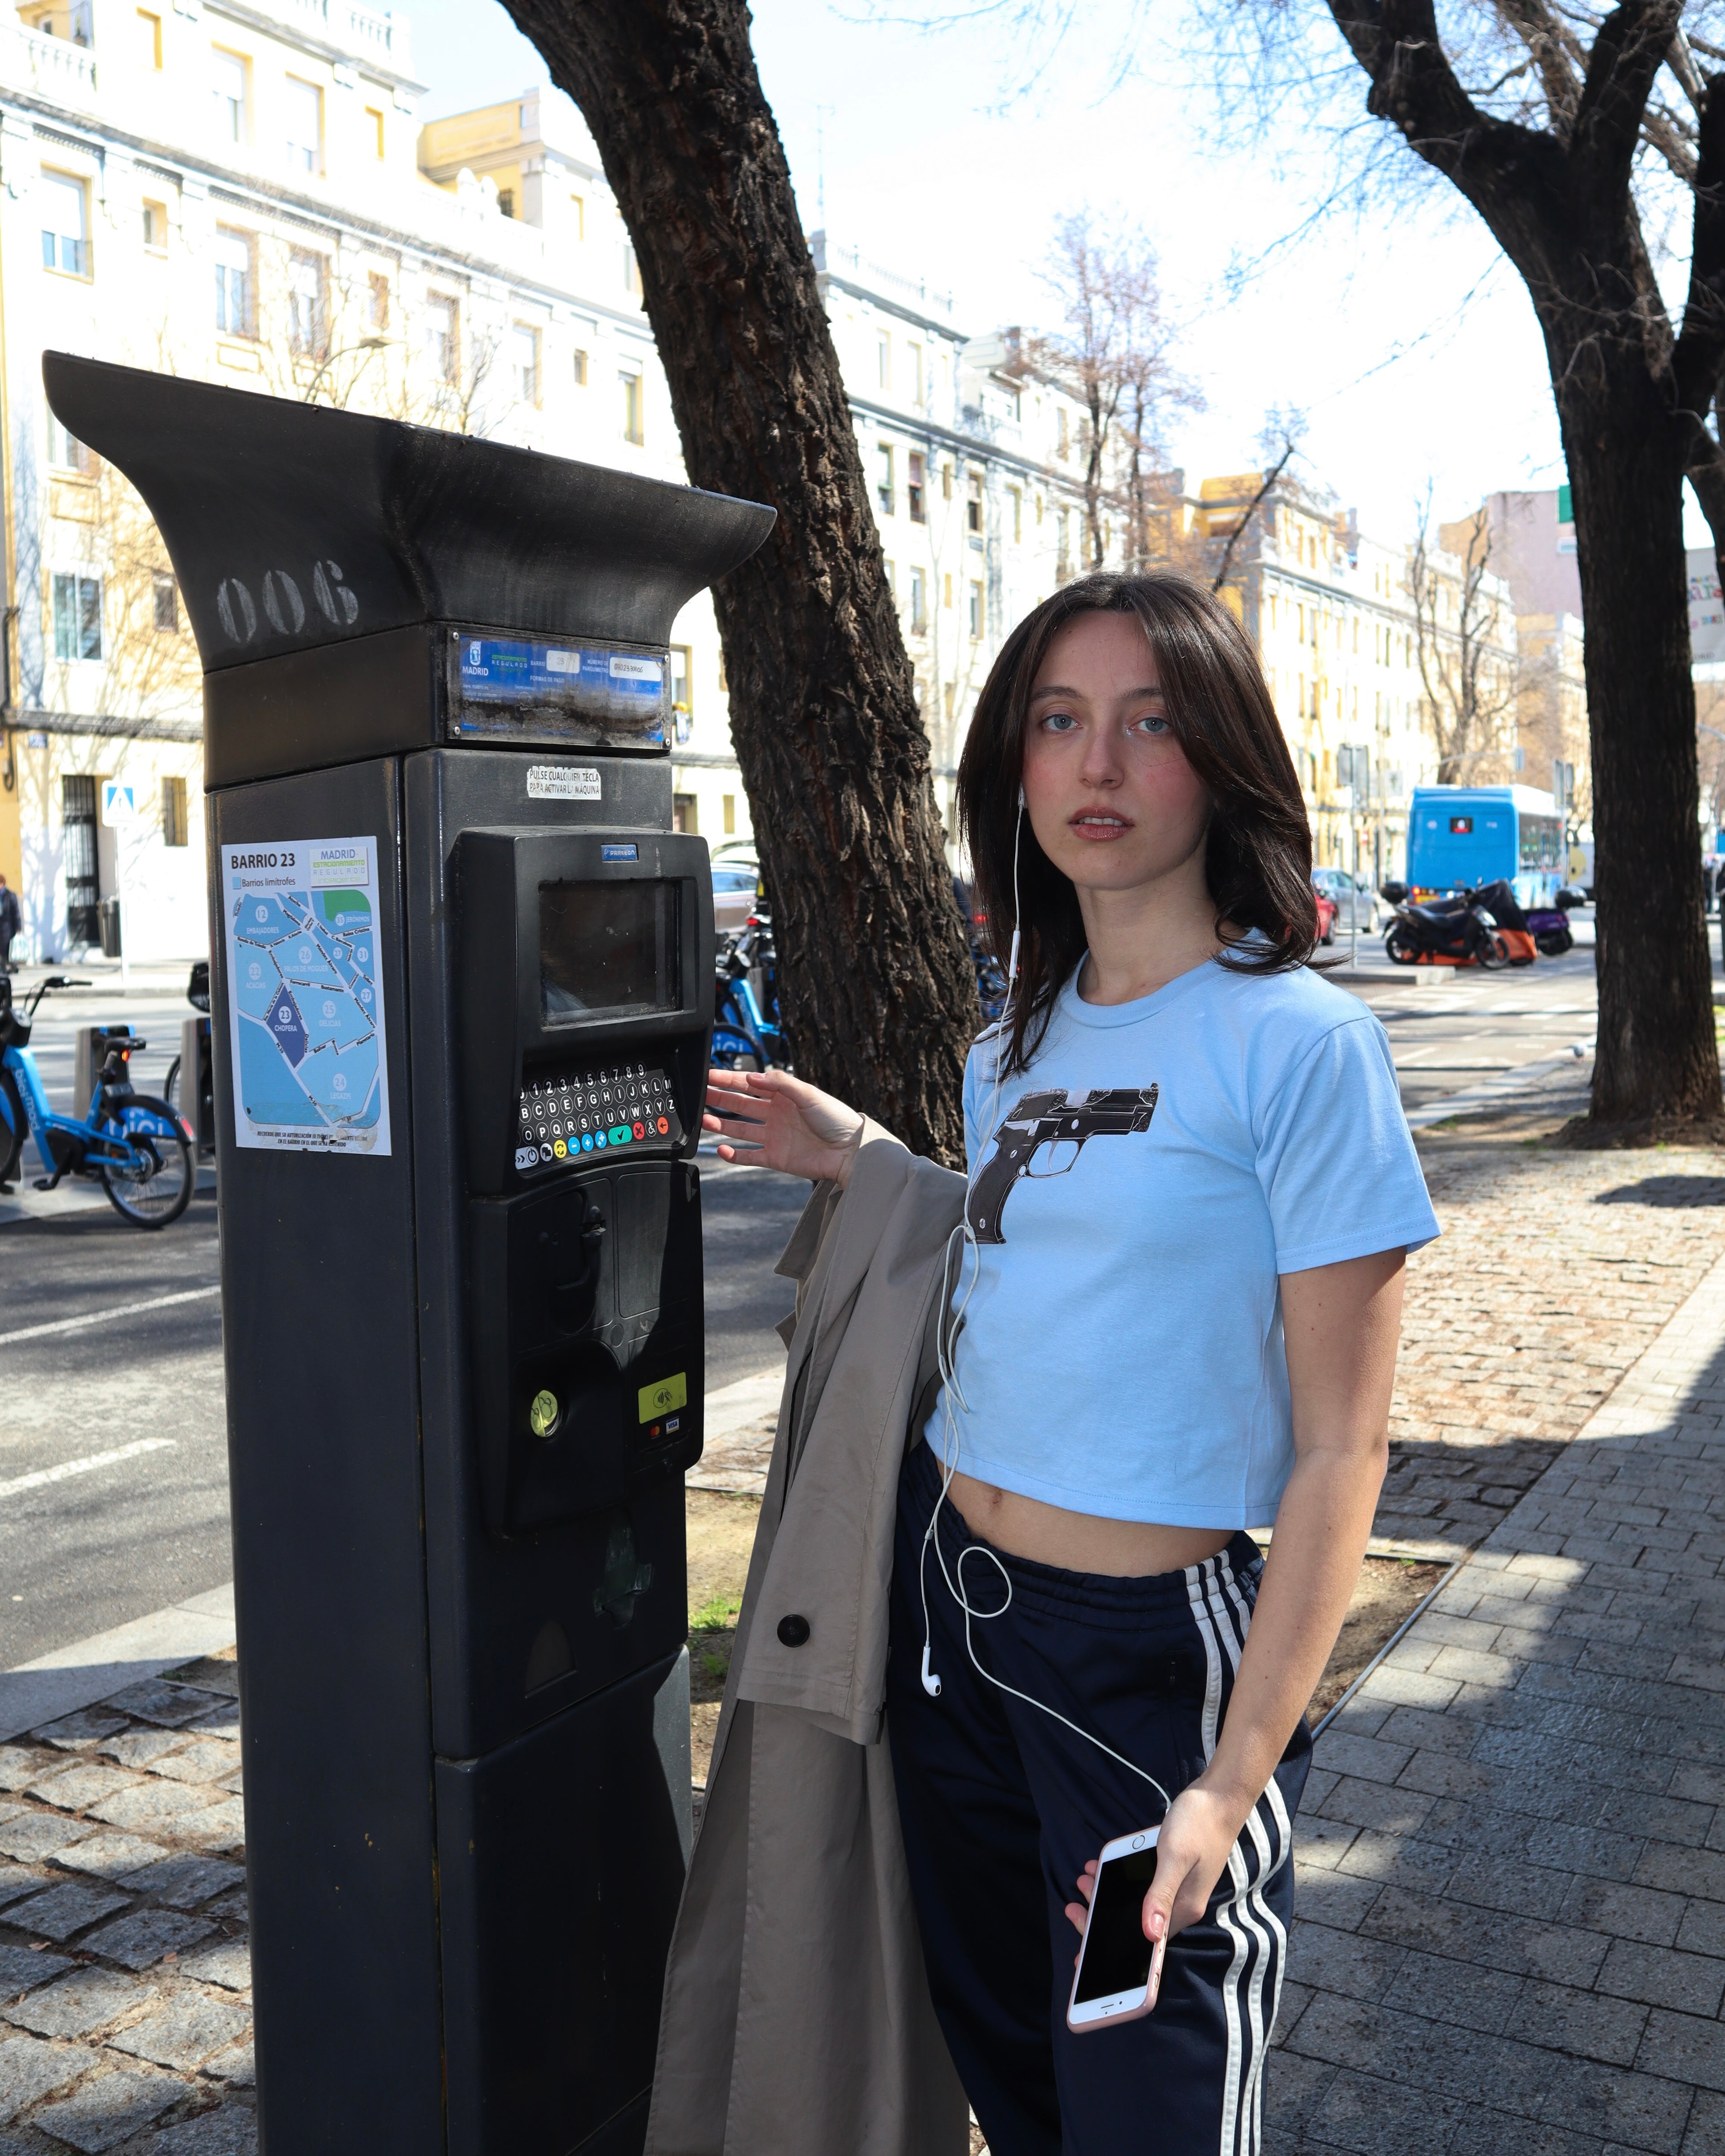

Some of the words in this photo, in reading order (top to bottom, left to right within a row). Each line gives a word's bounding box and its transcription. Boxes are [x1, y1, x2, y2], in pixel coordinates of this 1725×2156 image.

[217, 559, 359, 643] 006
[462, 666, 489, 676] MADRID
[530, 770, 547, 780] PULSE
[583, 773, 599, 782] TECLA
[545, 783, 566, 794] ACTIVAR
[575, 783, 599, 795] MÁQUINA
[321, 849, 355, 860] MADRID
[231, 853, 277, 869] BARRIO
[280, 853, 295, 867] 23
[313, 867, 365, 875] REGULADO
[242, 879, 263, 887] Barrios
[265, 876, 296, 886] limítrofes
[288, 896, 301, 907] Atocha
[257, 910, 266, 919] 12
[283, 909, 301, 926] Magdalena
[346, 915, 370, 923] JERÓNIMOS
[247, 927, 279, 935] EMBAJADORES
[336, 937, 352, 948] Barcelona
[301, 950, 310, 959] 26
[269, 950, 283, 978] Embajadores
[251, 967, 260, 976] 22
[288, 990, 302, 1020] Embajadores
[324, 1005, 334, 1014] 25
[280, 1010, 290, 1019] 23
[356, 1033, 375, 1046] Planetario
[276, 1043, 284, 1054] M-30
[335, 1078, 345, 1087] 24
[533, 1083, 538, 1095] 1
[546, 1081, 553, 1094] 2
[560, 1078, 567, 1091] 3
[574, 1076, 580, 1088] 4
[587, 1074, 593, 1086] 5
[600, 1071, 606, 1083] 6
[613, 1069, 619, 1080] 7
[626, 1066, 632, 1078] 8
[638, 1064, 644, 1076] 9
[309, 1096, 317, 1106] M-30
[522, 1108, 528, 1118] B
[535, 1105, 542, 1115] C
[549, 1103, 556, 1113] D
[564, 1100, 571, 1110] E
[577, 1096, 583, 1107] F
[590, 1094, 597, 1104] G
[603, 1091, 610, 1102] H
[618, 1089, 621, 1099] I
[630, 1087, 635, 1096] J
[641, 1083, 648, 1094] K
[654, 1082, 659, 1091] L
[664, 1079, 672, 1089] M
[540, 1127, 545, 1138] P
[553, 1124, 561, 1135] Q
[567, 1121, 575, 1131] R
[581, 1118, 588, 1128] S
[594, 1115, 600, 1125] T
[607, 1112, 613, 1122] U
[619, 1109, 625, 1119] V
[631, 1107, 639, 1117] W
[645, 1104, 651, 1114] X
[657, 1102, 662, 1112] Y
[668, 1100, 674, 1109] Z
[668, 1420, 678, 1429] VISA
